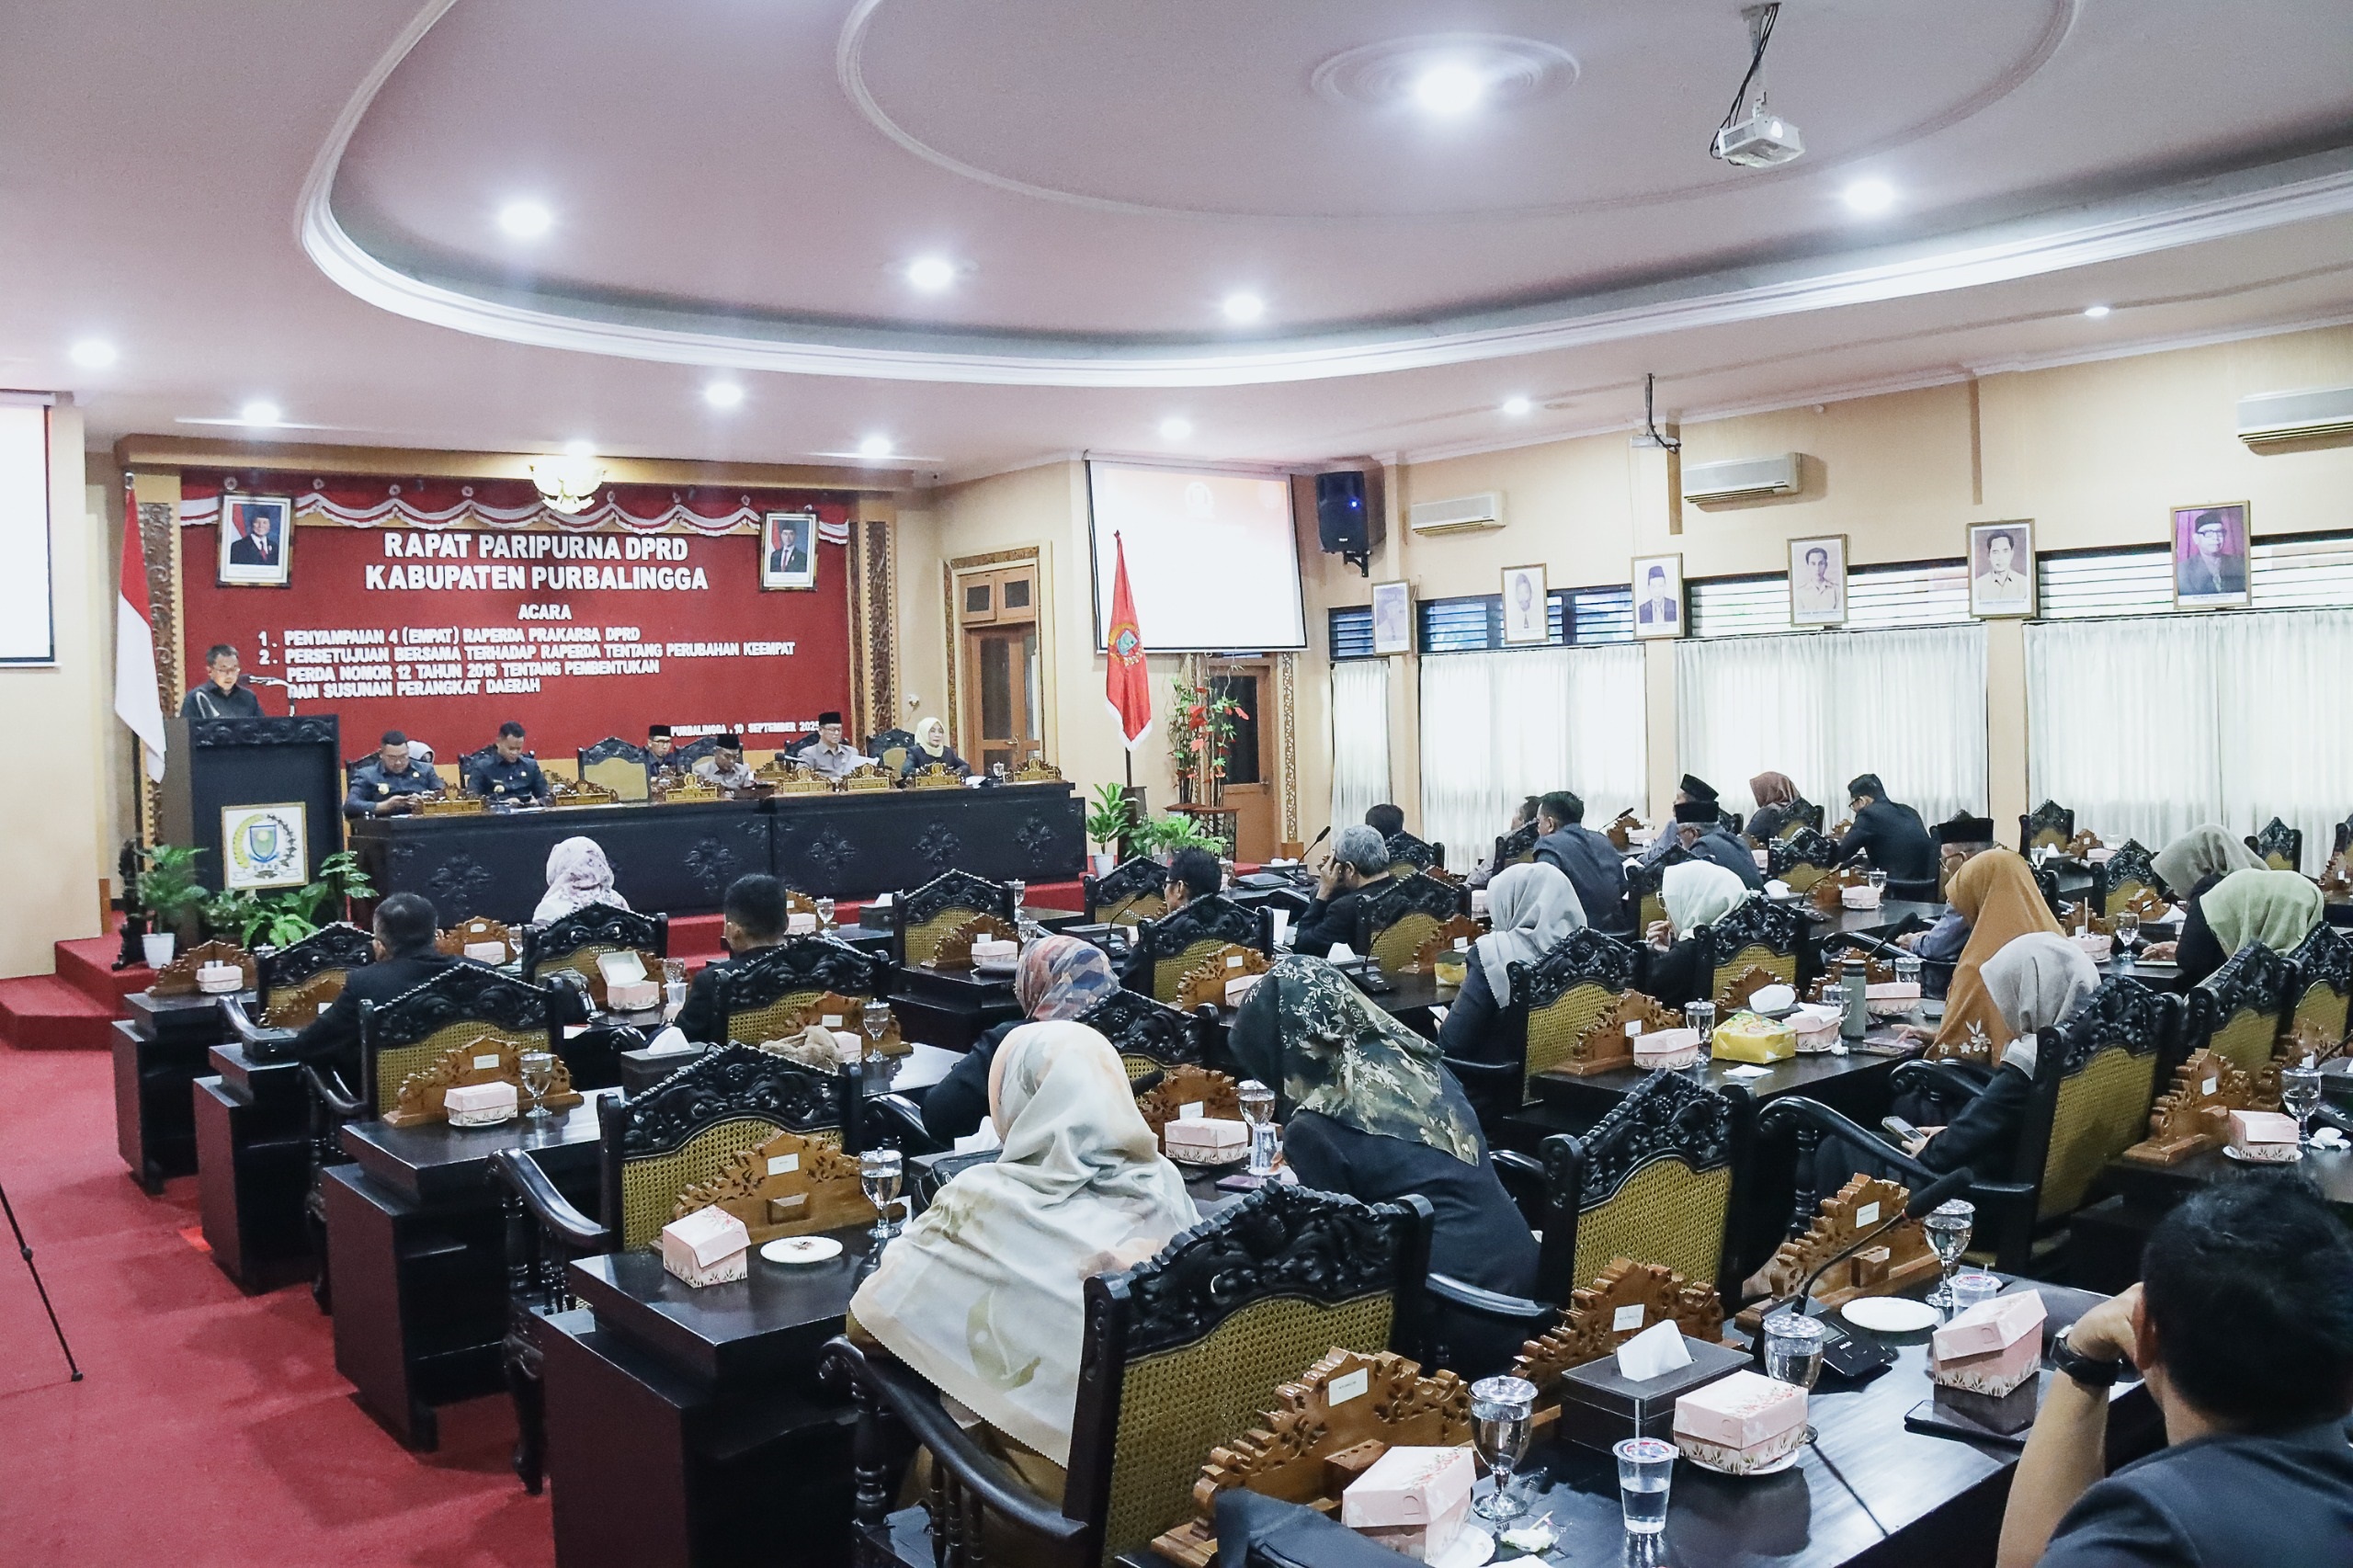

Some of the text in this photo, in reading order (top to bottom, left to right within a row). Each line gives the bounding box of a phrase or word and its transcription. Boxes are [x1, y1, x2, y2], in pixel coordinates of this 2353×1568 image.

[385, 533, 688, 561] RAPAT PARIPURNA DPRD
[366, 565, 708, 590] KABUPATEN PURBALINGGA
[518, 605, 572, 619] ACARA
[284, 630, 384, 645] PENYAMPAIAN
[389, 630, 398, 643] 4
[403, 626, 459, 645] (EMPAT)
[463, 628, 525, 642] RAPERDA
[529, 628, 601, 642] PRAKARSA
[606, 627, 640, 641] DPRD
[285, 647, 389, 664] PERSETUJUAN
[394, 646, 461, 661] BERSAMA
[464, 645, 537, 660] TERHADAP
[540, 644, 601, 659] RAPERDA
[604, 643, 663, 658] TENTANG
[666, 642, 739, 656] PERUBAHAN
[744, 642, 795, 655] KEEMPAT
[287, 660, 659, 682] PERDA NOMOR 12 TAHUN 2016 TENTANG PEMBENTUKAN
[288, 676, 540, 699] DAN SUSUNAN PERANGKAT DAERAH
[734, 723, 744, 733] 10
[748, 722, 796, 733] SEPTEMBER
